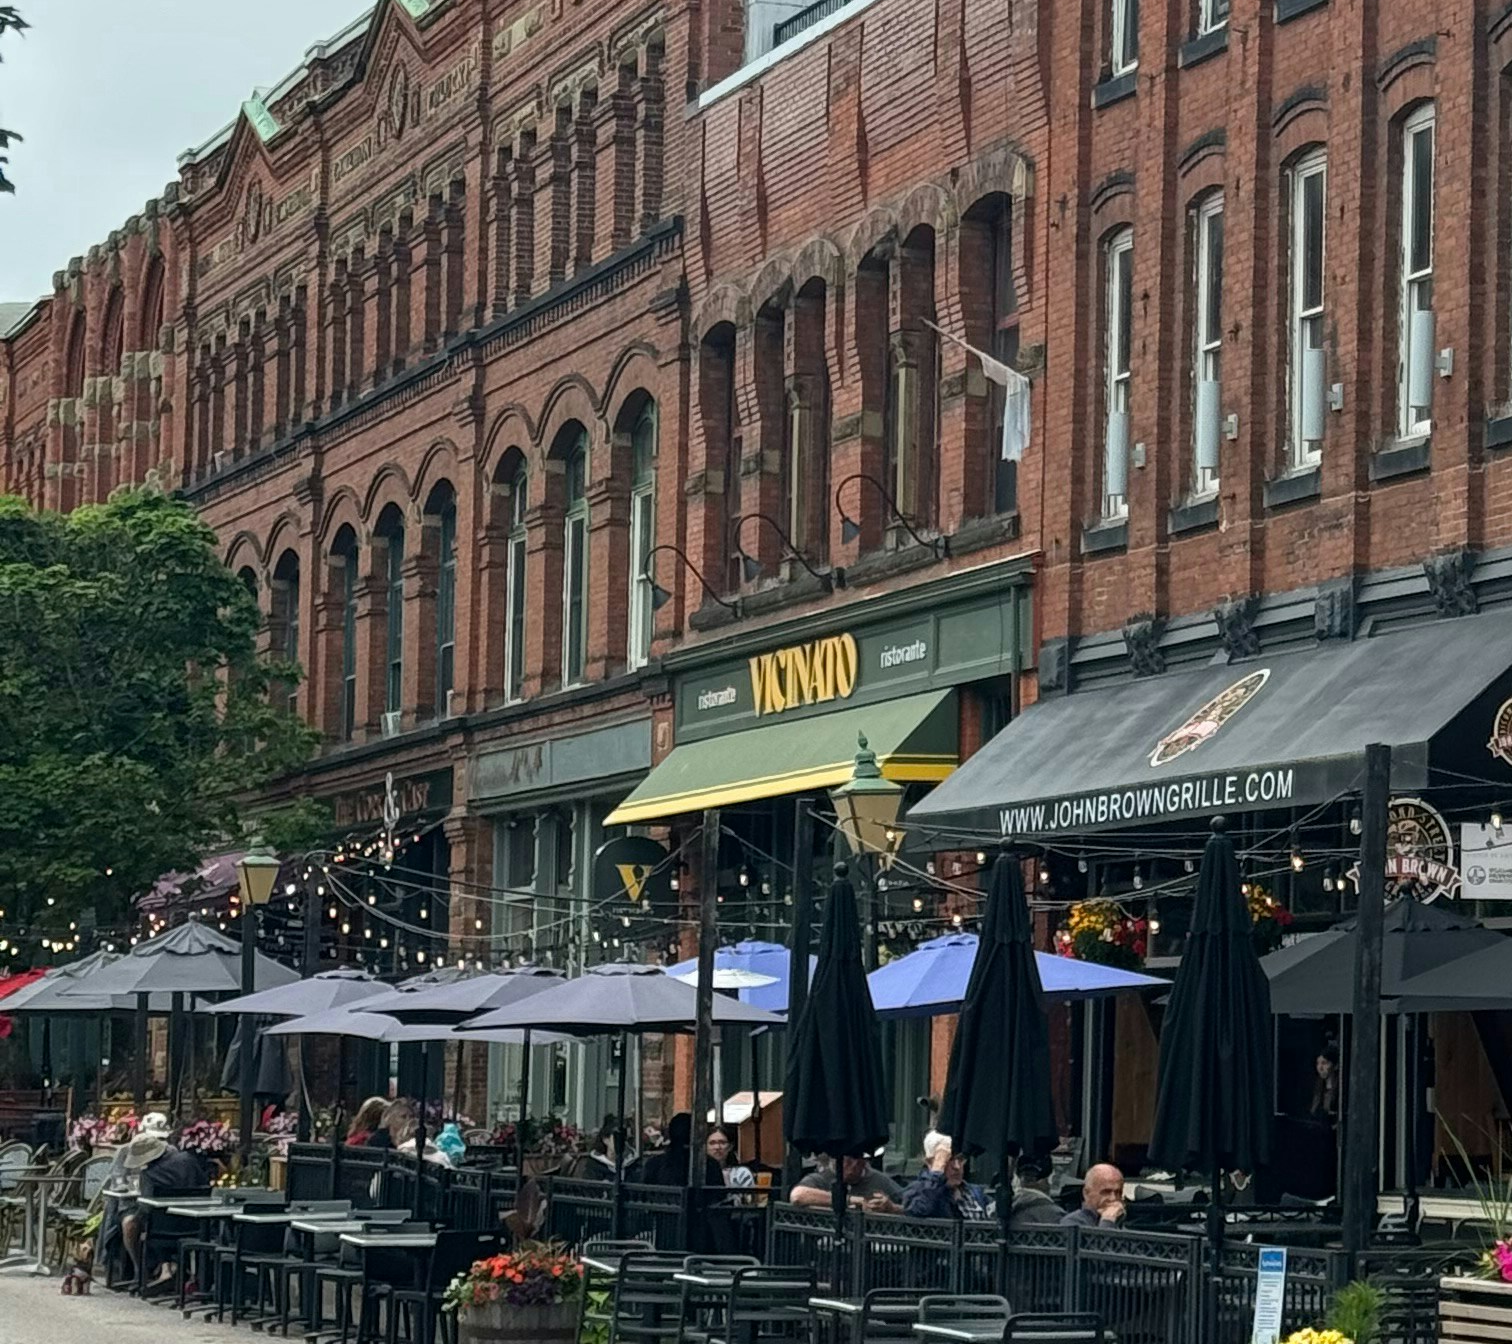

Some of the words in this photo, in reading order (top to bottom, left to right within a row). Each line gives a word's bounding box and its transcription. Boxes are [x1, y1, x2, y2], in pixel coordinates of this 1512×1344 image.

[748, 632, 858, 719] VICINATO
[880, 639, 927, 669] ristorante
[999, 768, 1294, 836] WWW.JOHNBROWNGRILLE.COM
[1401, 857, 1449, 884] BROWN
